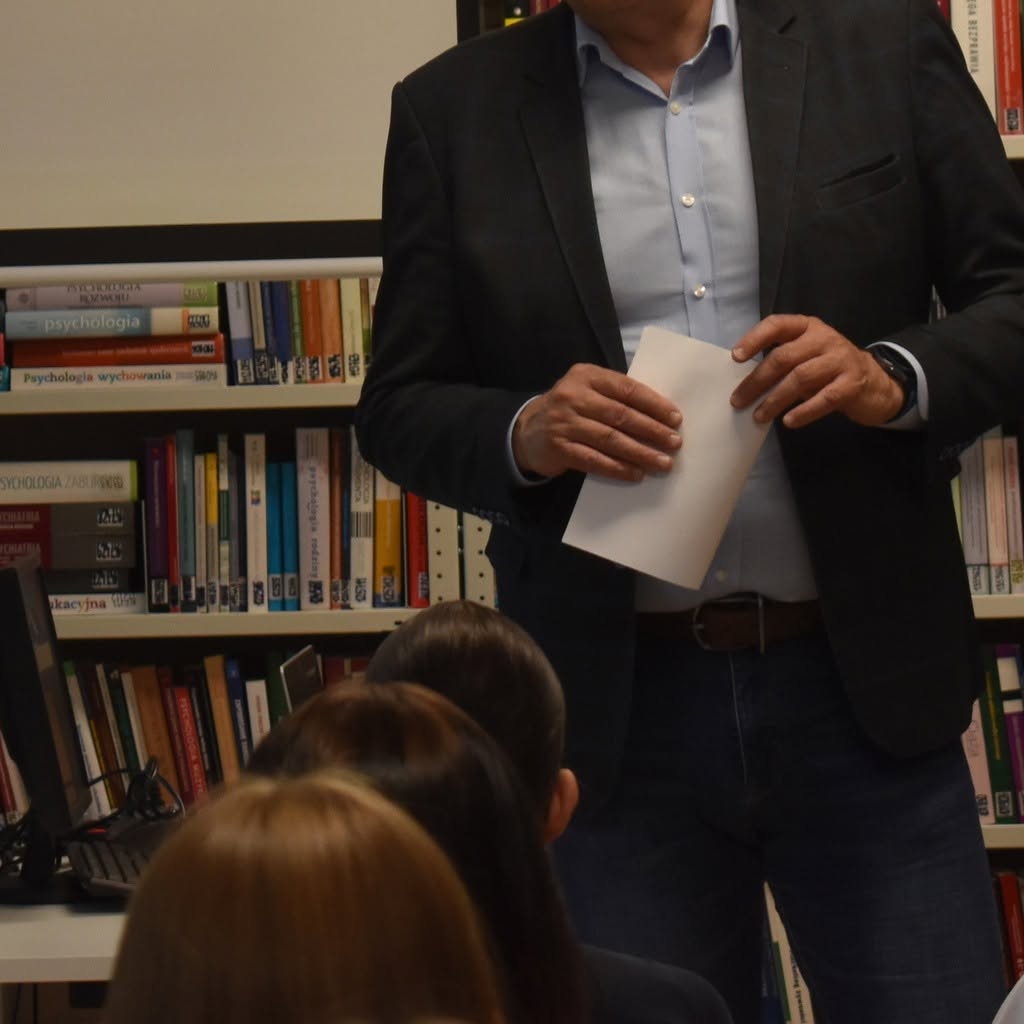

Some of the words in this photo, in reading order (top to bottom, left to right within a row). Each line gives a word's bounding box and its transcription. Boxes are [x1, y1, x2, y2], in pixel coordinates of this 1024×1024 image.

[967, 19, 980, 75] BEZPRAWIA
[44, 313, 142, 332] psychologia
[23, 370, 94, 386] Psychologia
[97, 369, 172, 384] wychowania
[306, 465, 320, 533] psychologia
[308, 538, 319, 579] rodziny
